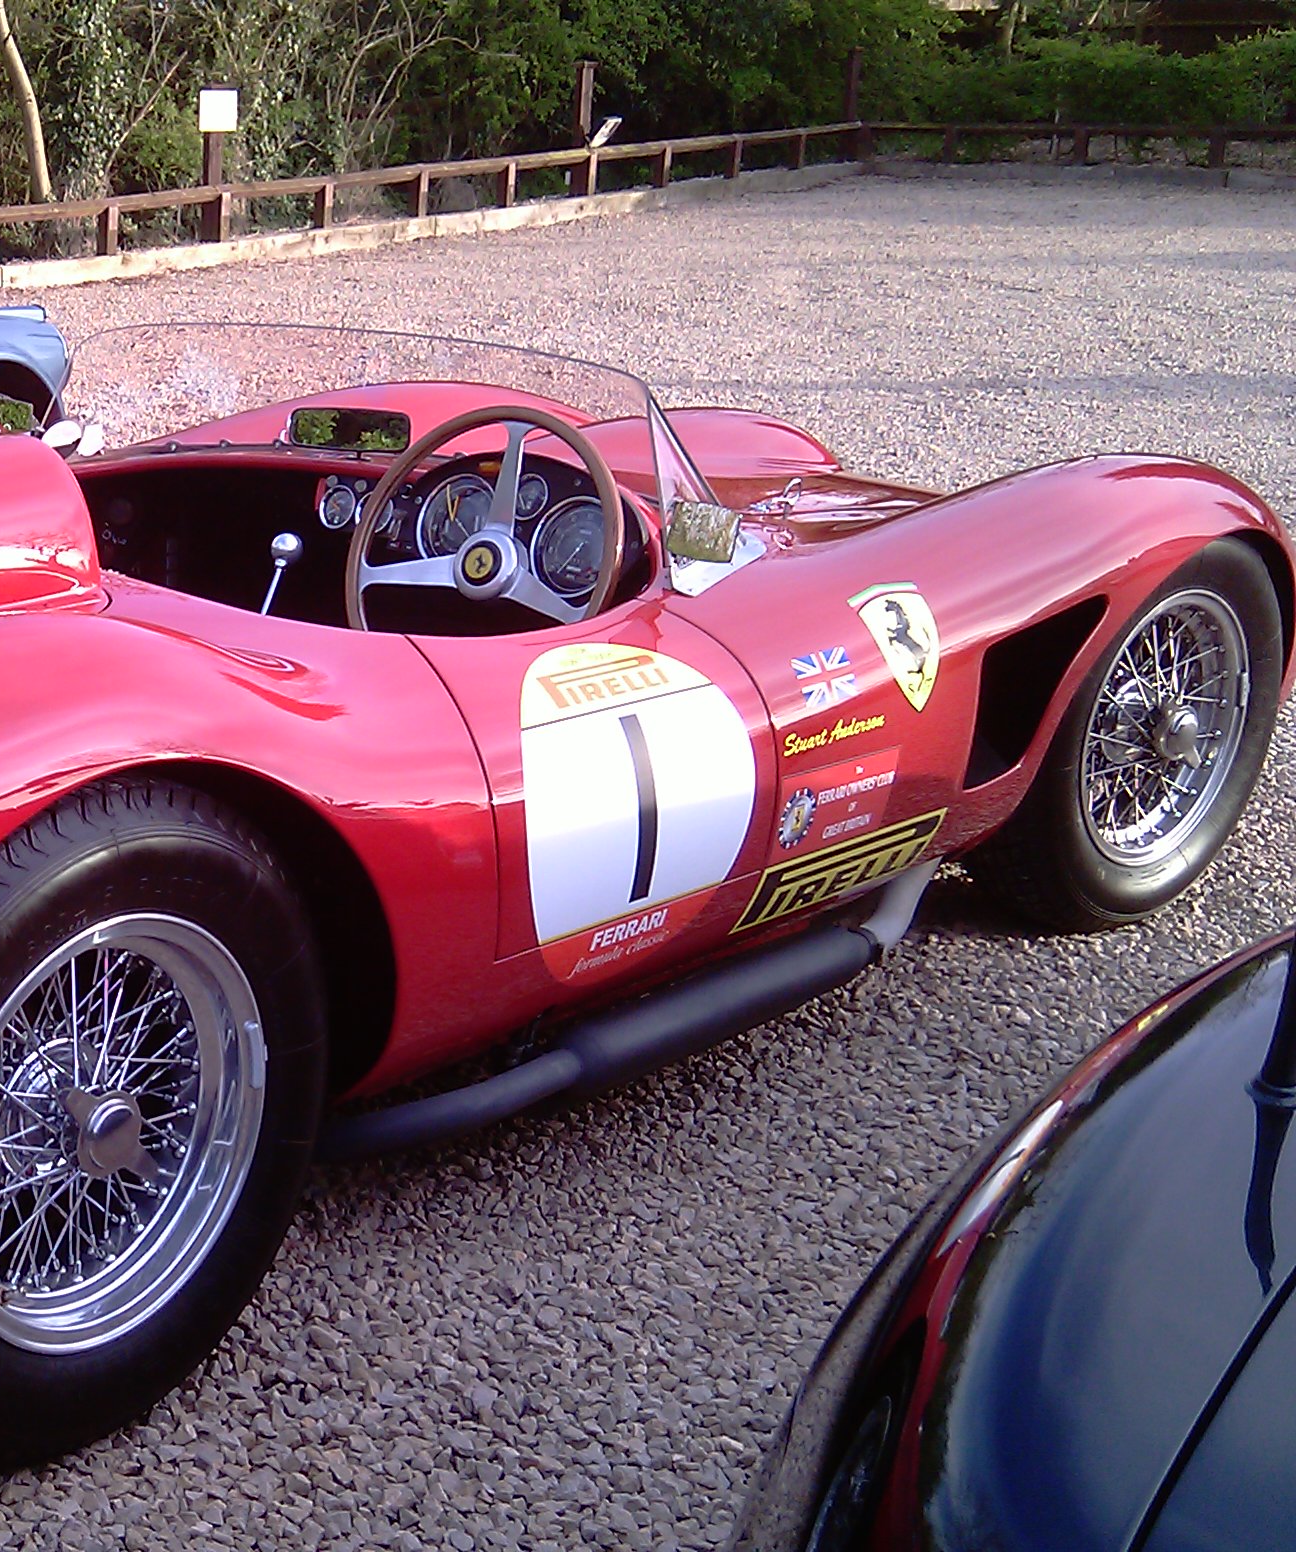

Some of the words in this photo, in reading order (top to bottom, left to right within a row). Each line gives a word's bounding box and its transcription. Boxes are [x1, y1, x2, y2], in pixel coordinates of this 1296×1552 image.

[536, 655, 669, 709] PIRELLI
[783, 729, 828, 757] Stuart
[827, 714, 885, 744] Anderson
[618, 713, 659, 904] 1
[817, 784, 848, 806] FERRARI
[877, 771, 896, 787] CLUB
[734, 813, 944, 932] PIRELLI
[589, 908, 668, 953] FERRARI
[566, 944, 625, 980] formula
